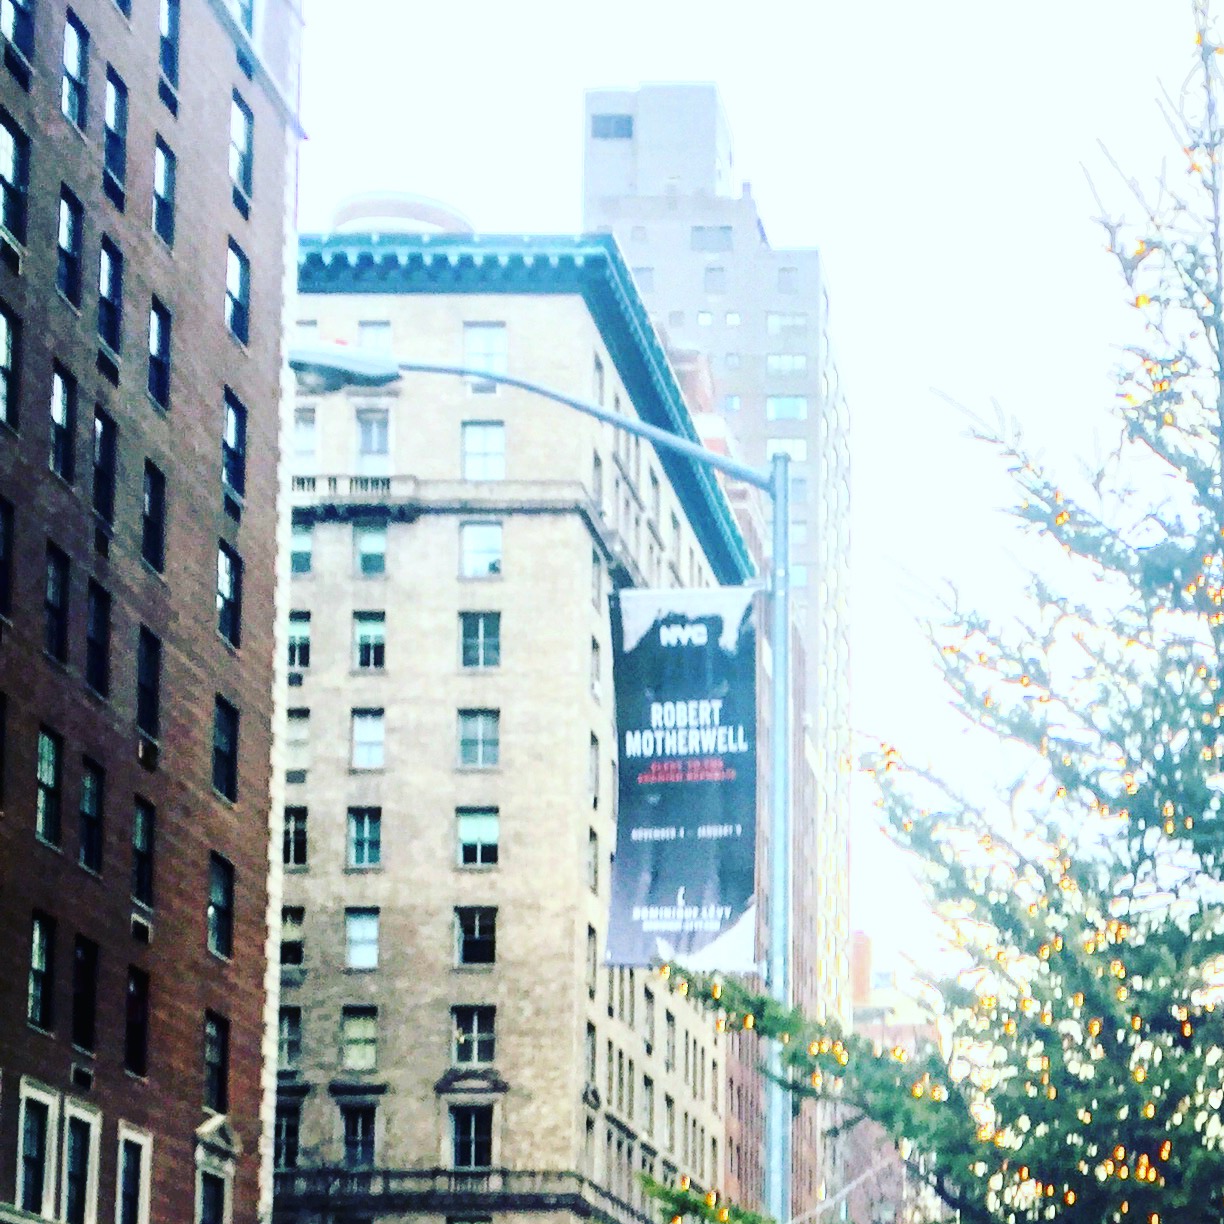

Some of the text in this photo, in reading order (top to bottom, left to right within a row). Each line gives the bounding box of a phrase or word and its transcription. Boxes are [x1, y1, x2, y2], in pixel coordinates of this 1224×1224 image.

[660, 624, 707, 646] NYC
[651, 700, 723, 729] ROBERT
[625, 725, 749, 758] MOTHERWELL
